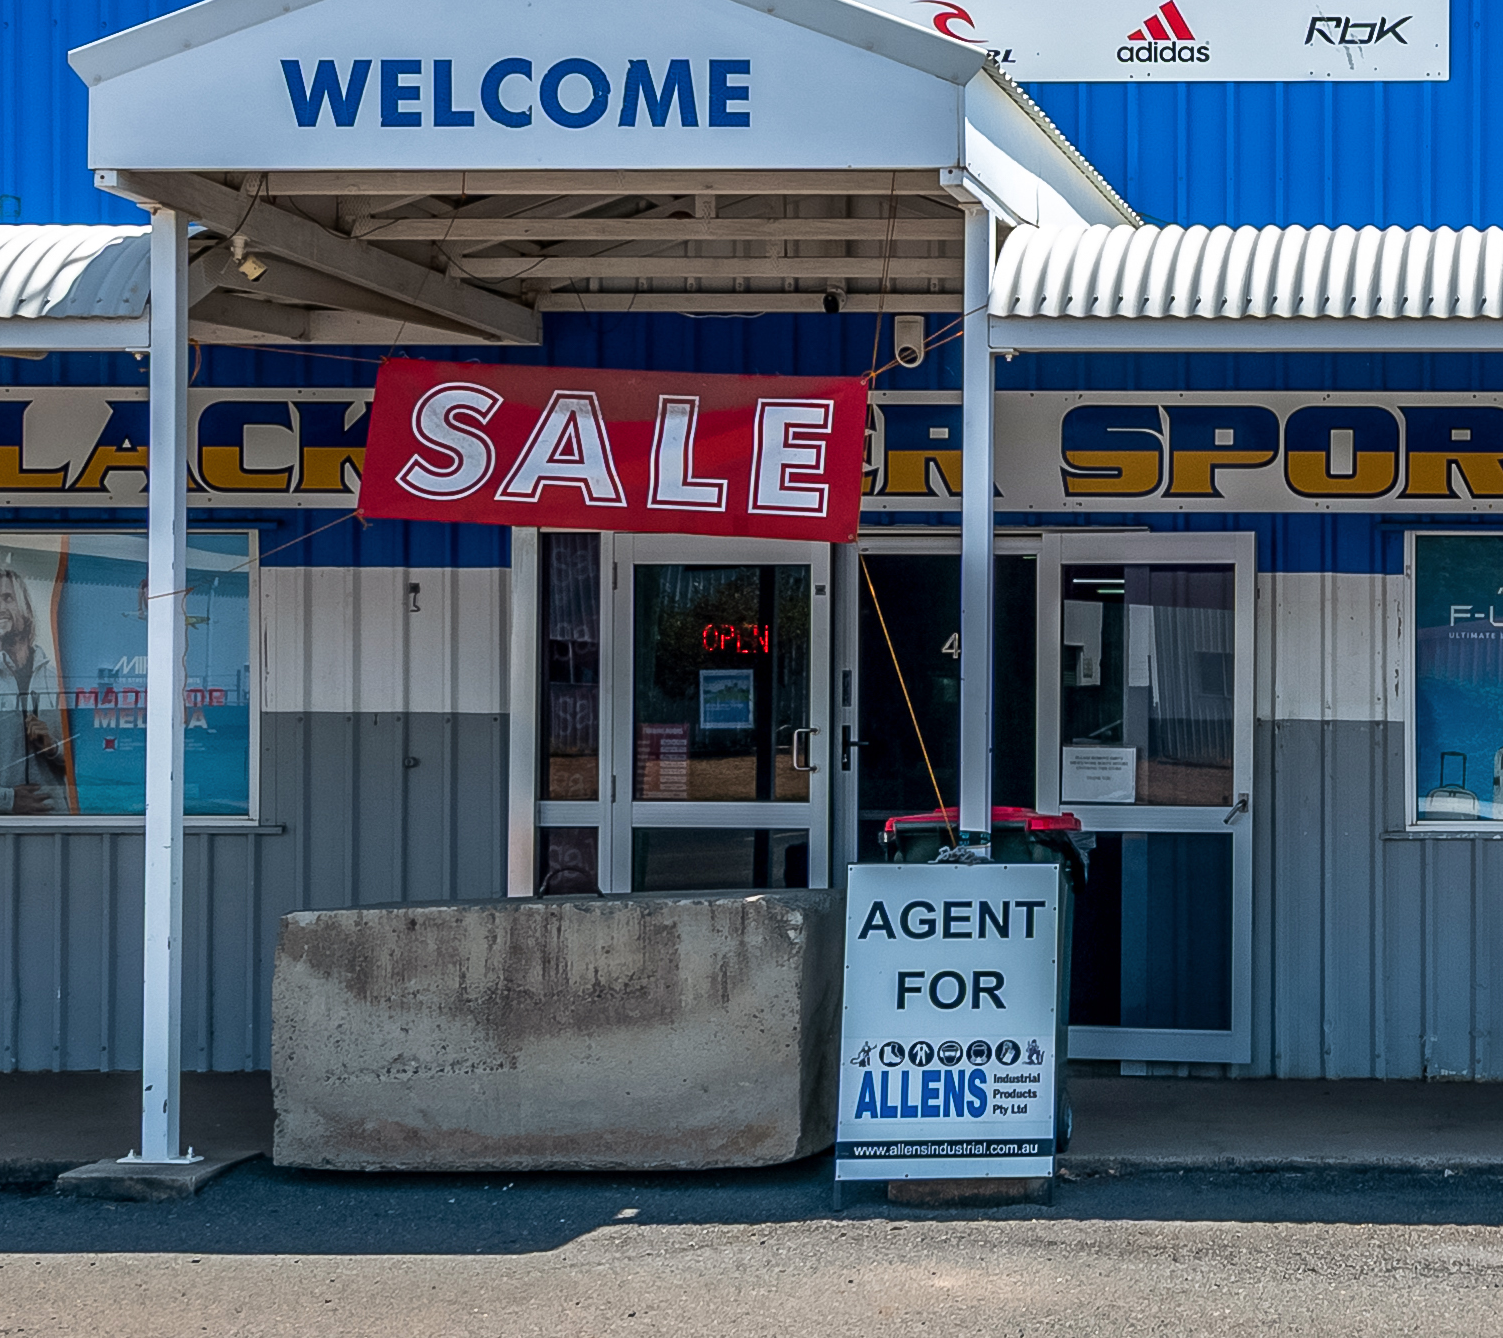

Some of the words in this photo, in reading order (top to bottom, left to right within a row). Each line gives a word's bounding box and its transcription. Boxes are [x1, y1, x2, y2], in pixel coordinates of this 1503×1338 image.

[1116, 41, 1210, 63] adidas
[280, 58, 752, 130] WELCOME
[395, 381, 836, 518] SALE
[702, 623, 770, 654] OPEN
[1448, 631, 1496, 640] ULTIMATE
[857, 899, 1046, 941] AGENT
[895, 970, 1007, 1010] FOR
[993, 1073, 1040, 1084] Industrial
[854, 1068, 988, 1119] ALLENS
[992, 1089, 1038, 1099] Products
[992, 1104, 1008, 1117] Pty
[1010, 1103, 1028, 1114] Ltd
[853, 1142, 1039, 1157] www.allensindustrial.com.au
